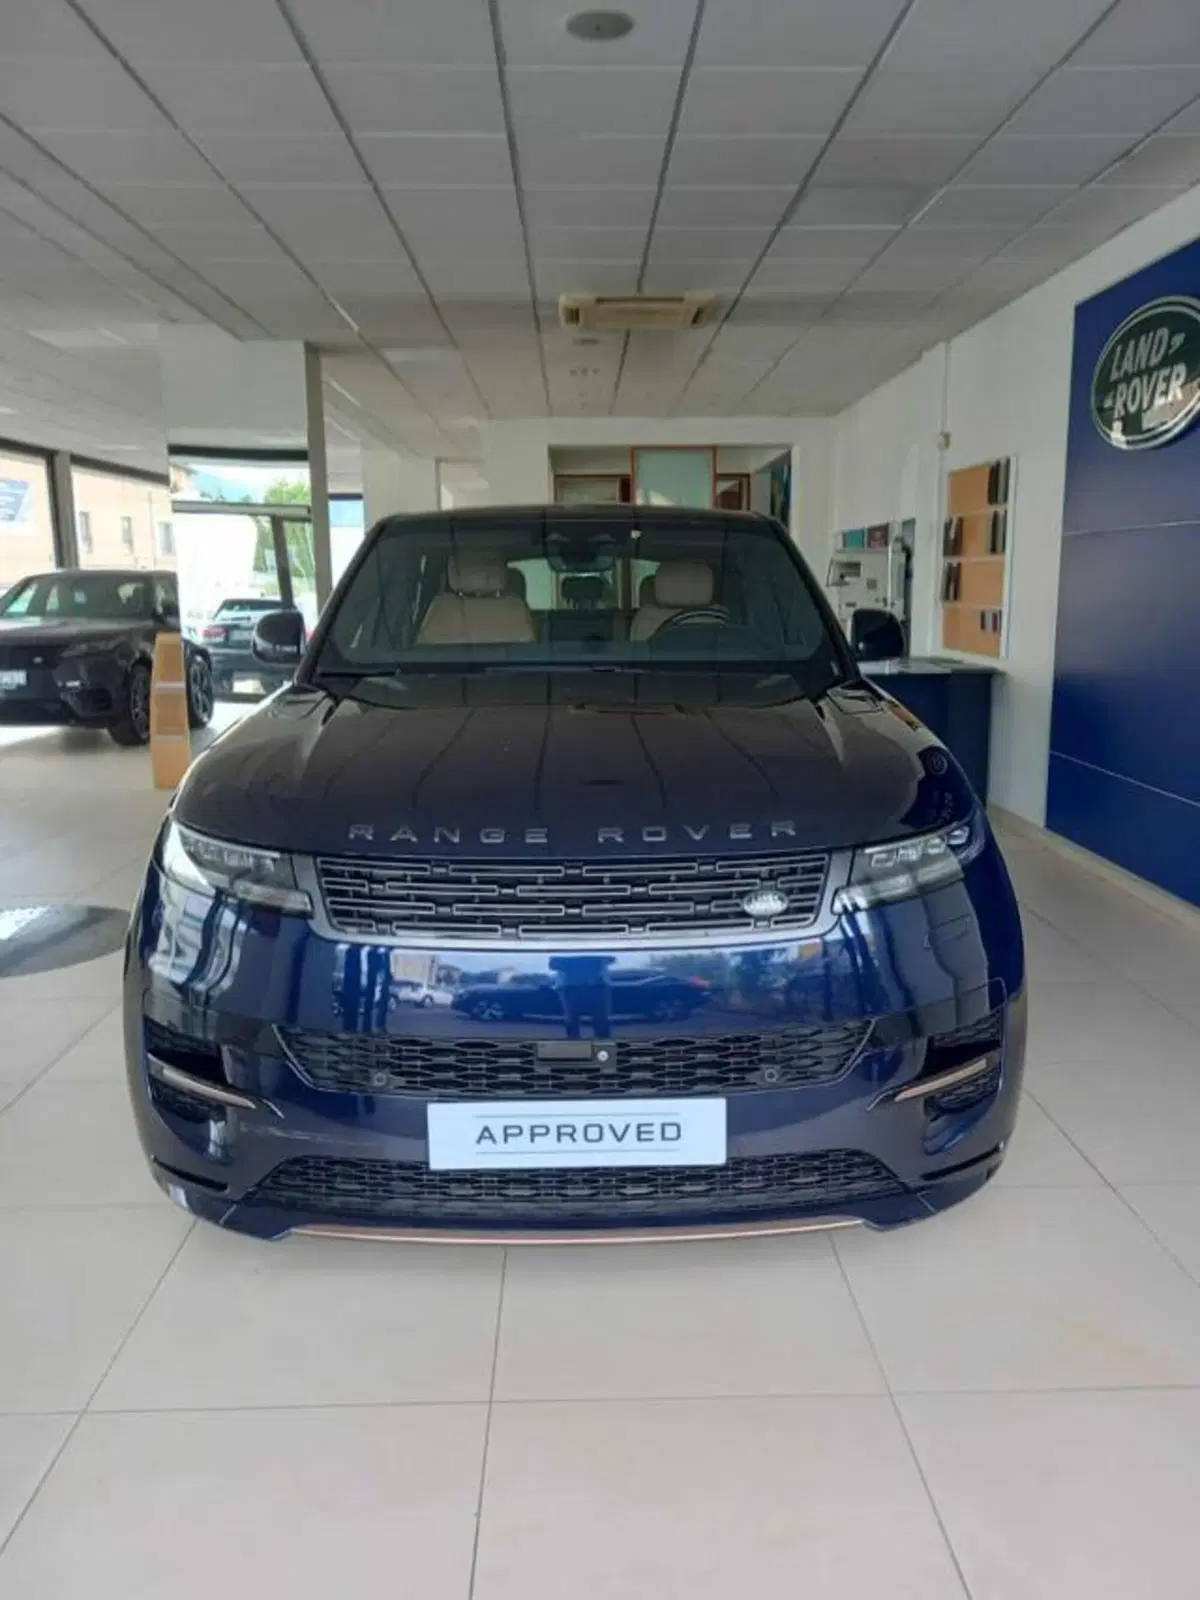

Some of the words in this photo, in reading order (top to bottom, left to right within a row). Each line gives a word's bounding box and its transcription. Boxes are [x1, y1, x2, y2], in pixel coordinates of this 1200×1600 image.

[1109, 327, 1170, 383] LAND
[1113, 362, 1187, 419] ROVER
[348, 823, 549, 844] RANGE
[597, 820, 797, 843] ROVER
[475, 1122, 682, 1145] APPROVED
